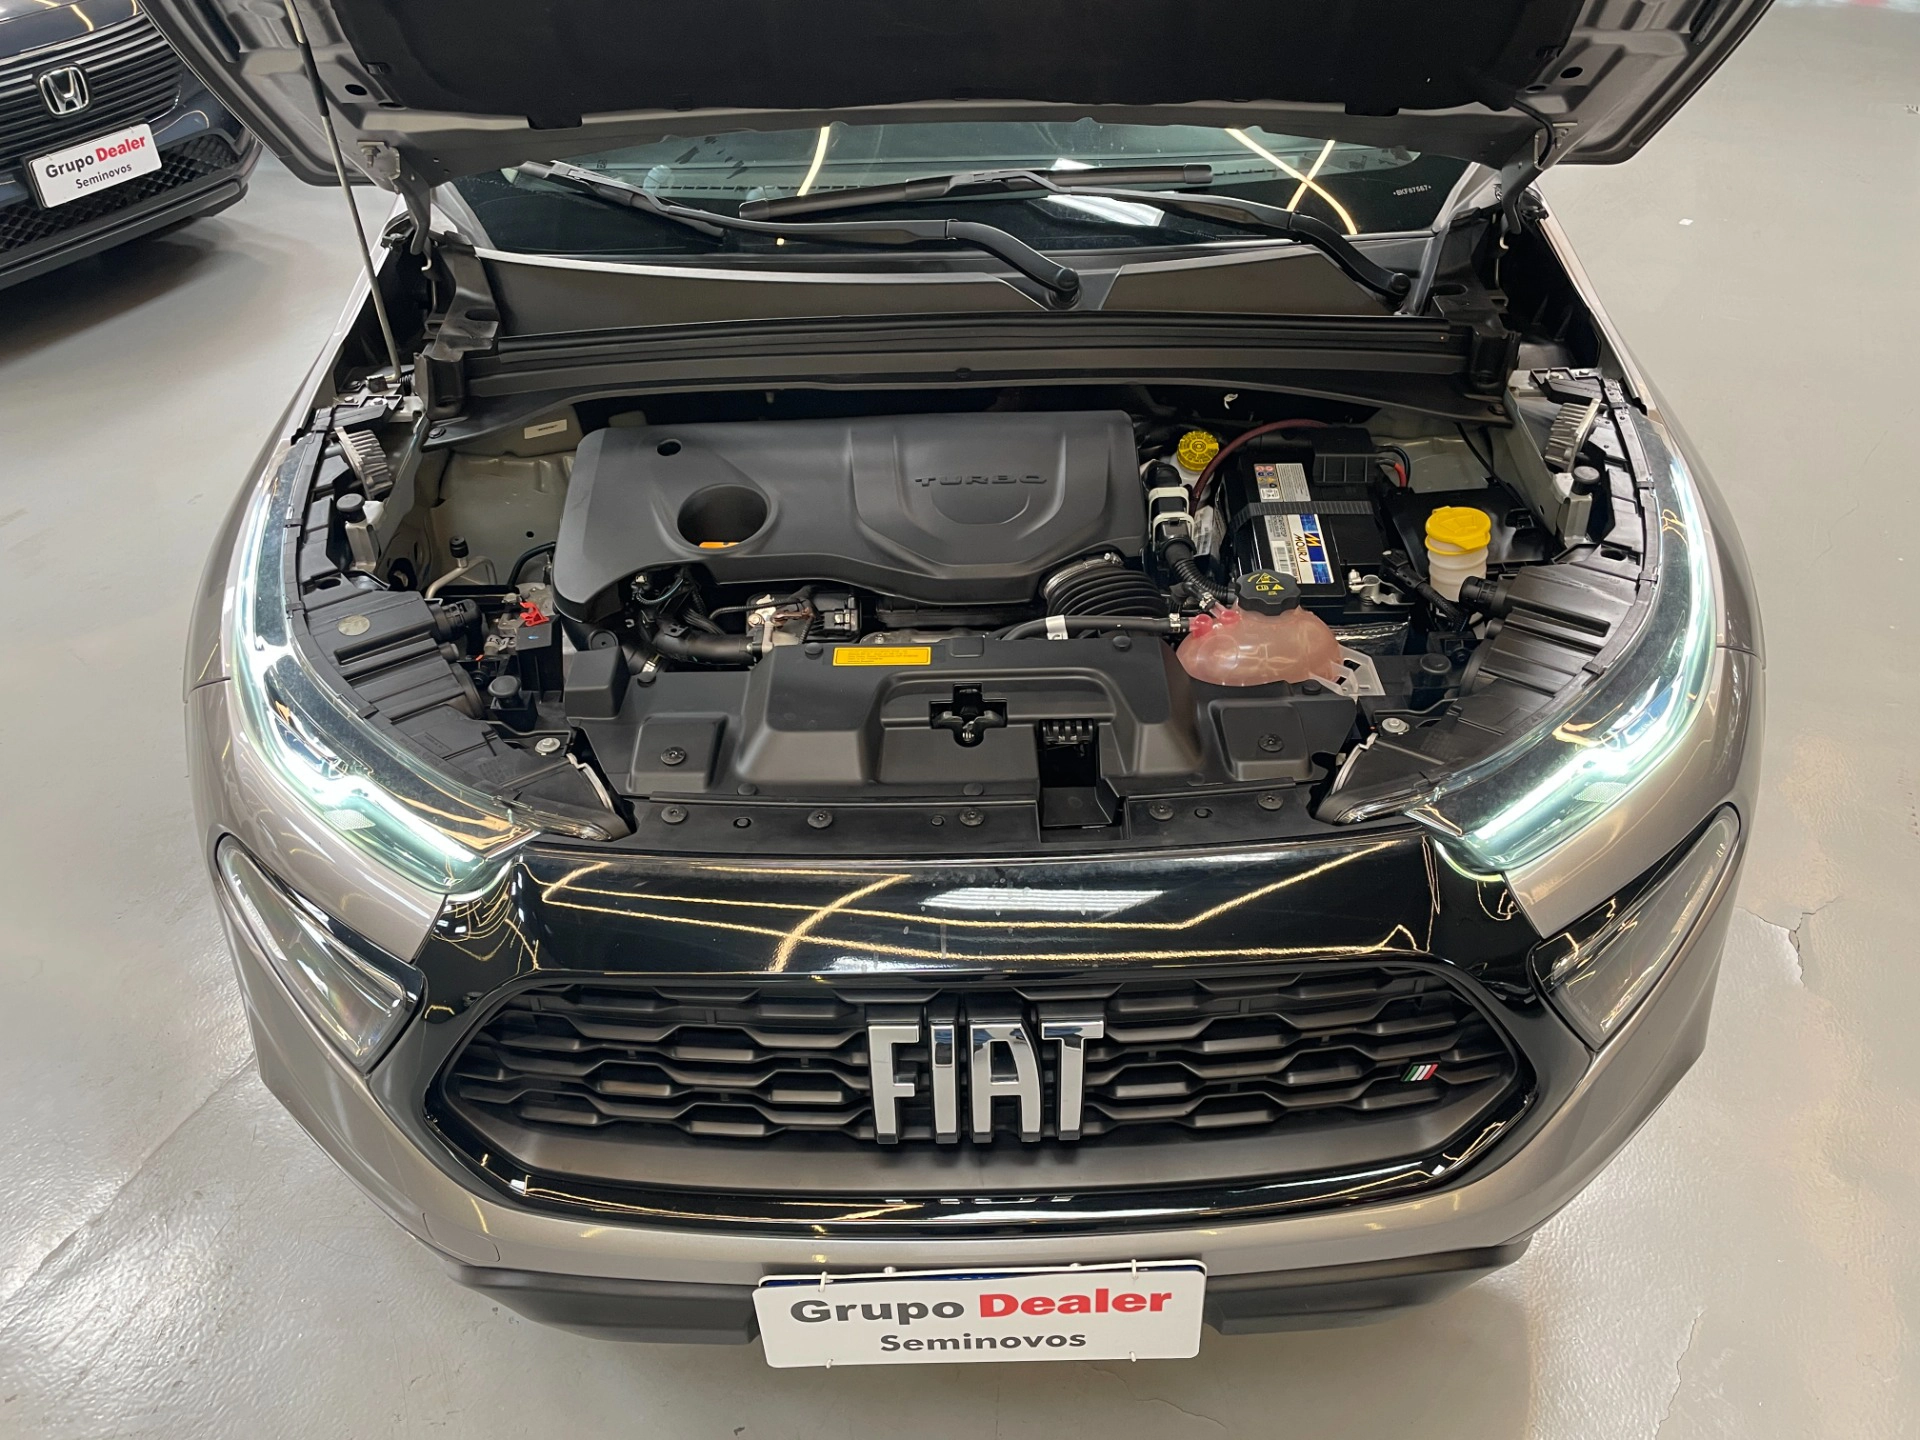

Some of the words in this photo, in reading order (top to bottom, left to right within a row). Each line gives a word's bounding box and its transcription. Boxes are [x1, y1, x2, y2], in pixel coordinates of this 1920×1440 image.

[45, 155, 94, 178] Grupo
[95, 136, 145, 162] Dealer
[75, 163, 132, 189] Seminovos
[914, 474, 1048, 488] TURBO
[1293, 533, 1309, 562] MOURA
[867, 1020, 1105, 1144] FIAT
[789, 1299, 965, 1325] Grupo
[979, 1288, 1173, 1318] Dealer
[880, 1332, 1087, 1352] Seminovos
